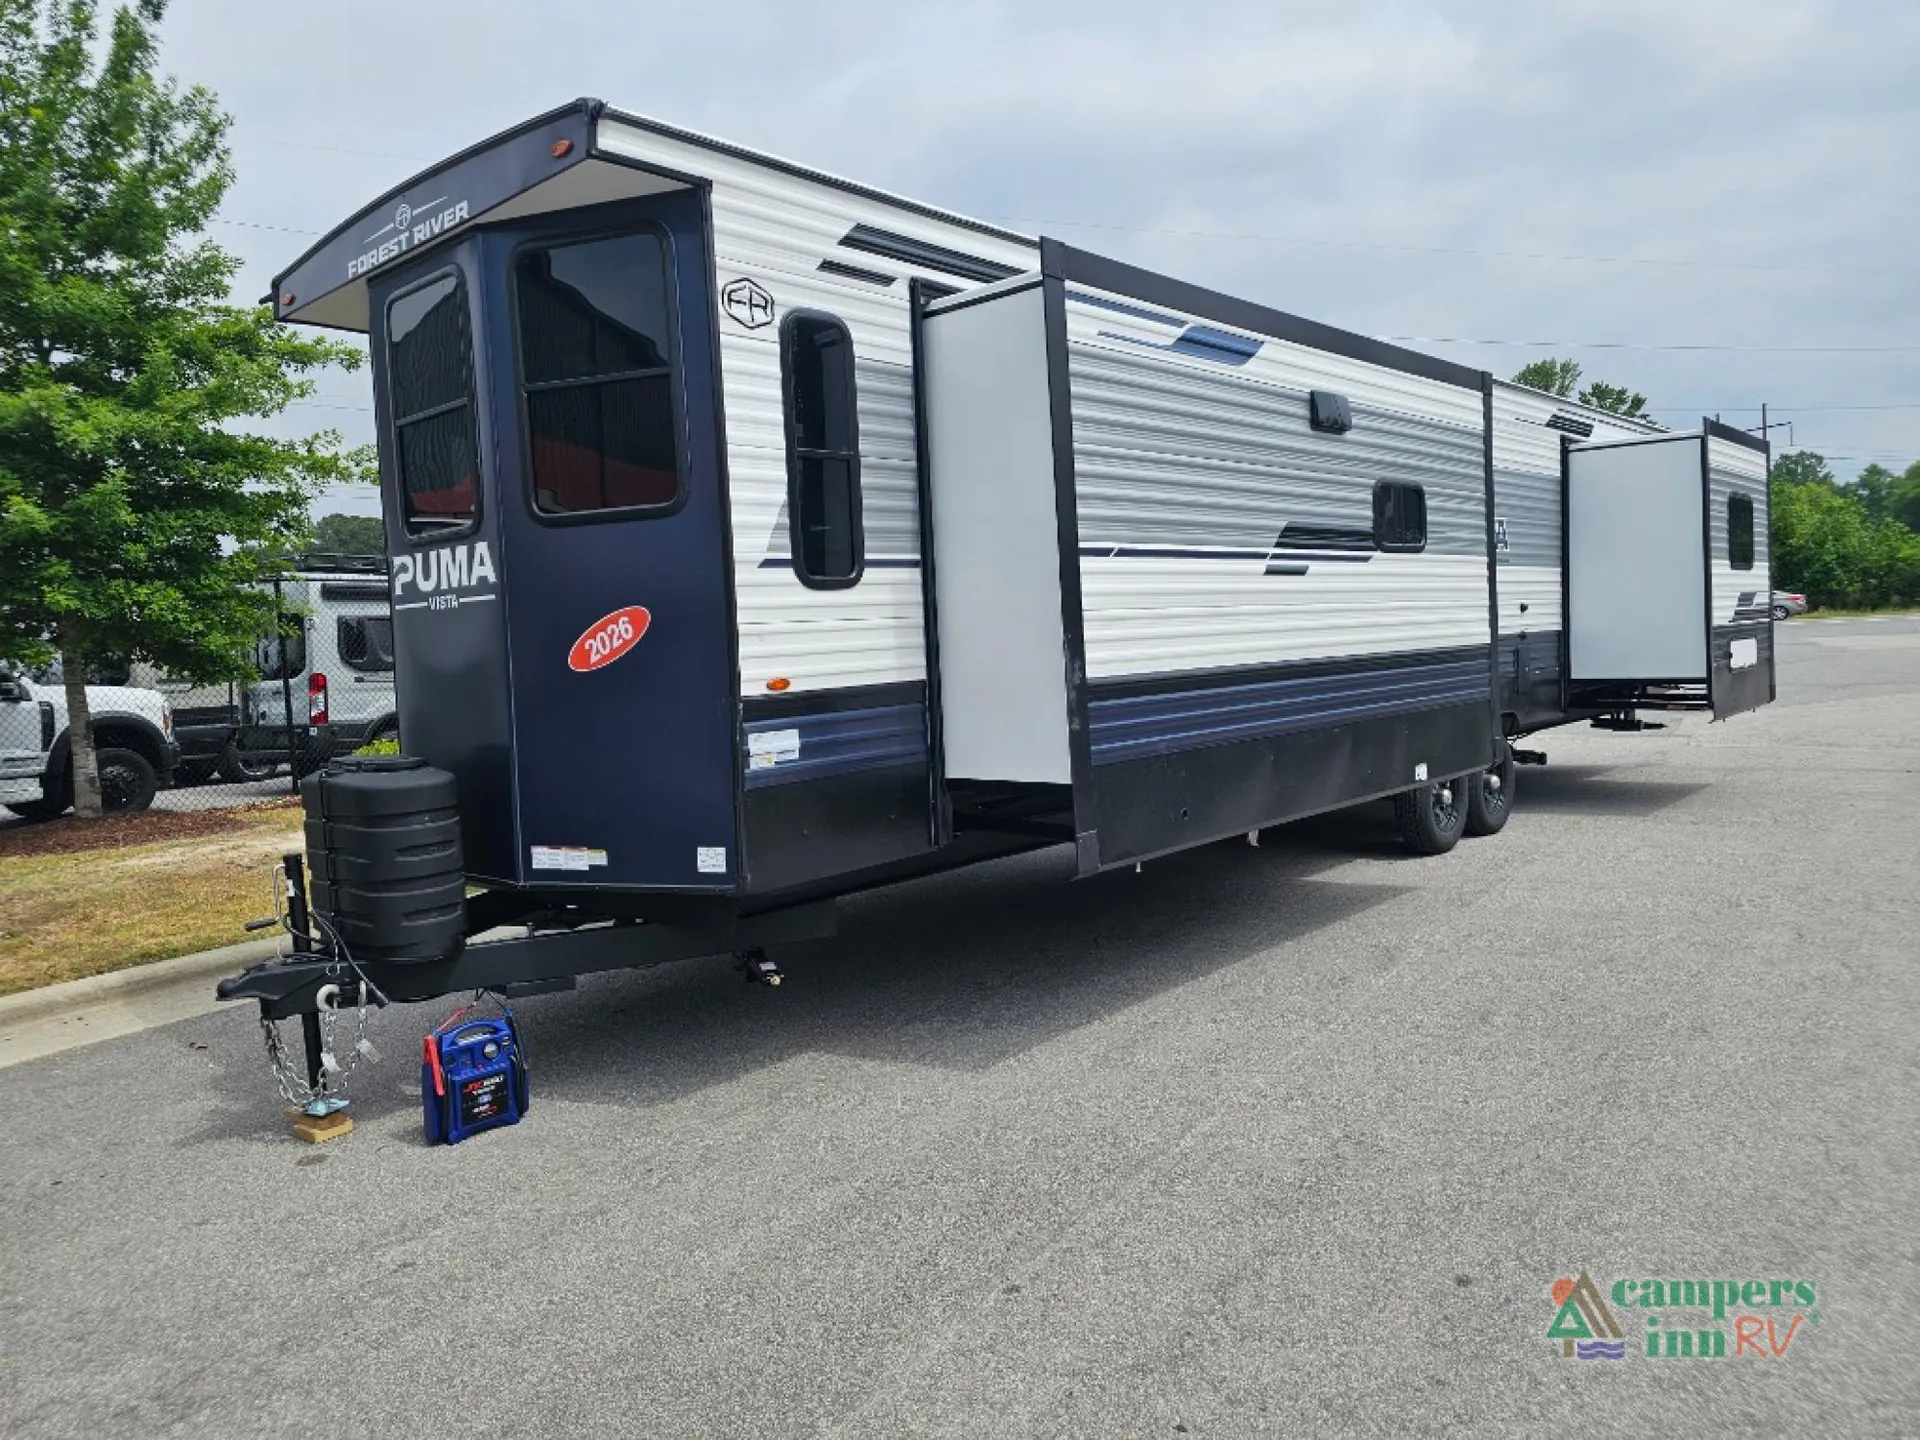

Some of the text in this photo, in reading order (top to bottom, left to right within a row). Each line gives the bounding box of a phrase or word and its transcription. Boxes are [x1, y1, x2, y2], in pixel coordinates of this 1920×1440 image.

[347, 231, 410, 280] FOREST
[412, 200, 470, 245] RIVER
[392, 541, 498, 595] PUMA
[428, 594, 460, 610] VISTA
[584, 616, 633, 665] 2026
